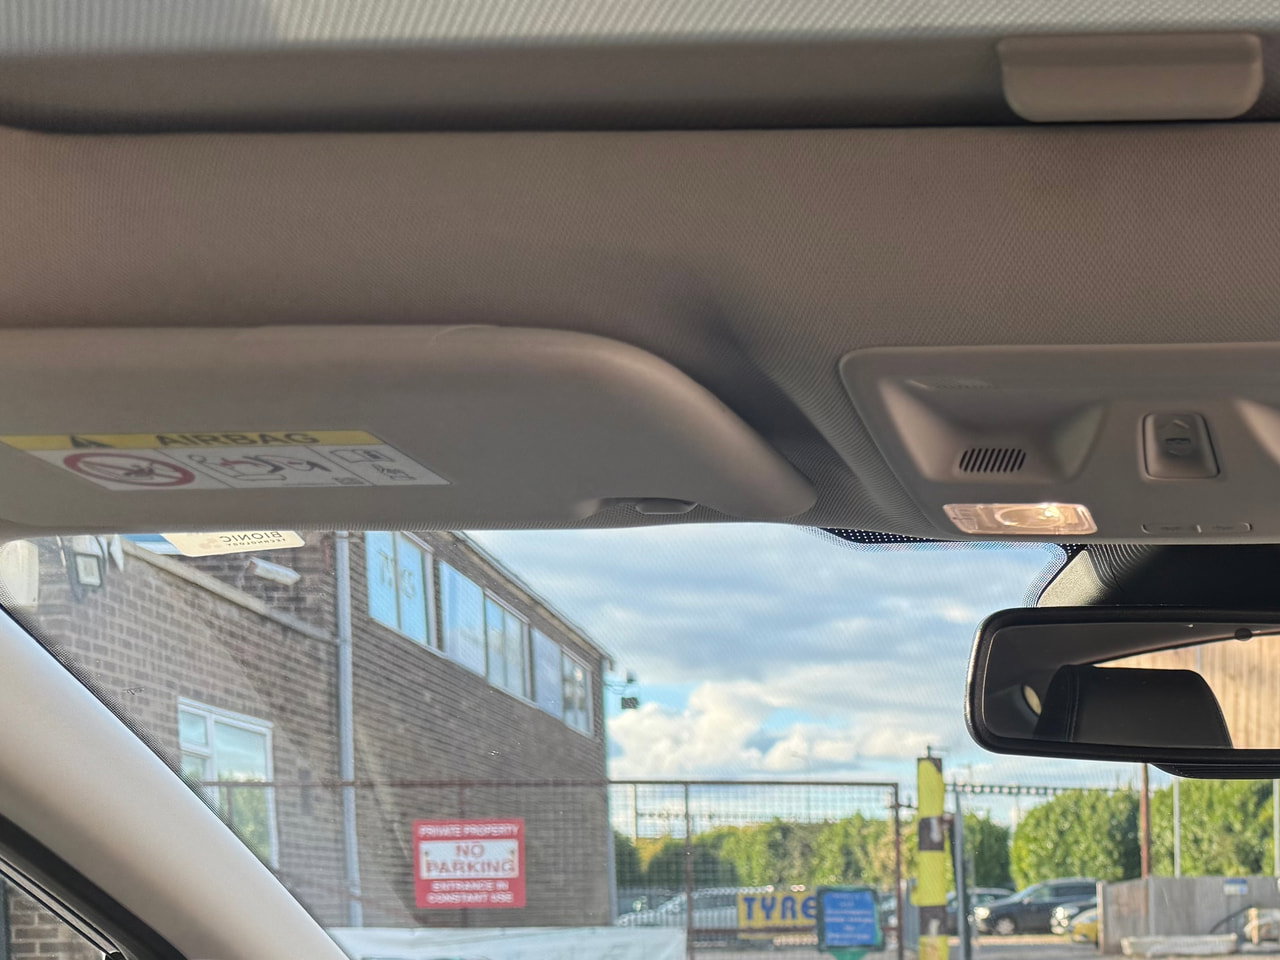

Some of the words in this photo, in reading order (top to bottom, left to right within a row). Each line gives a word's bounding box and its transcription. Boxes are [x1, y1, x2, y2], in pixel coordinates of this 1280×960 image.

[156, 433, 320, 447] AIRBAG
[455, 844, 484, 858] NO
[426, 860, 515, 873] PARKING
